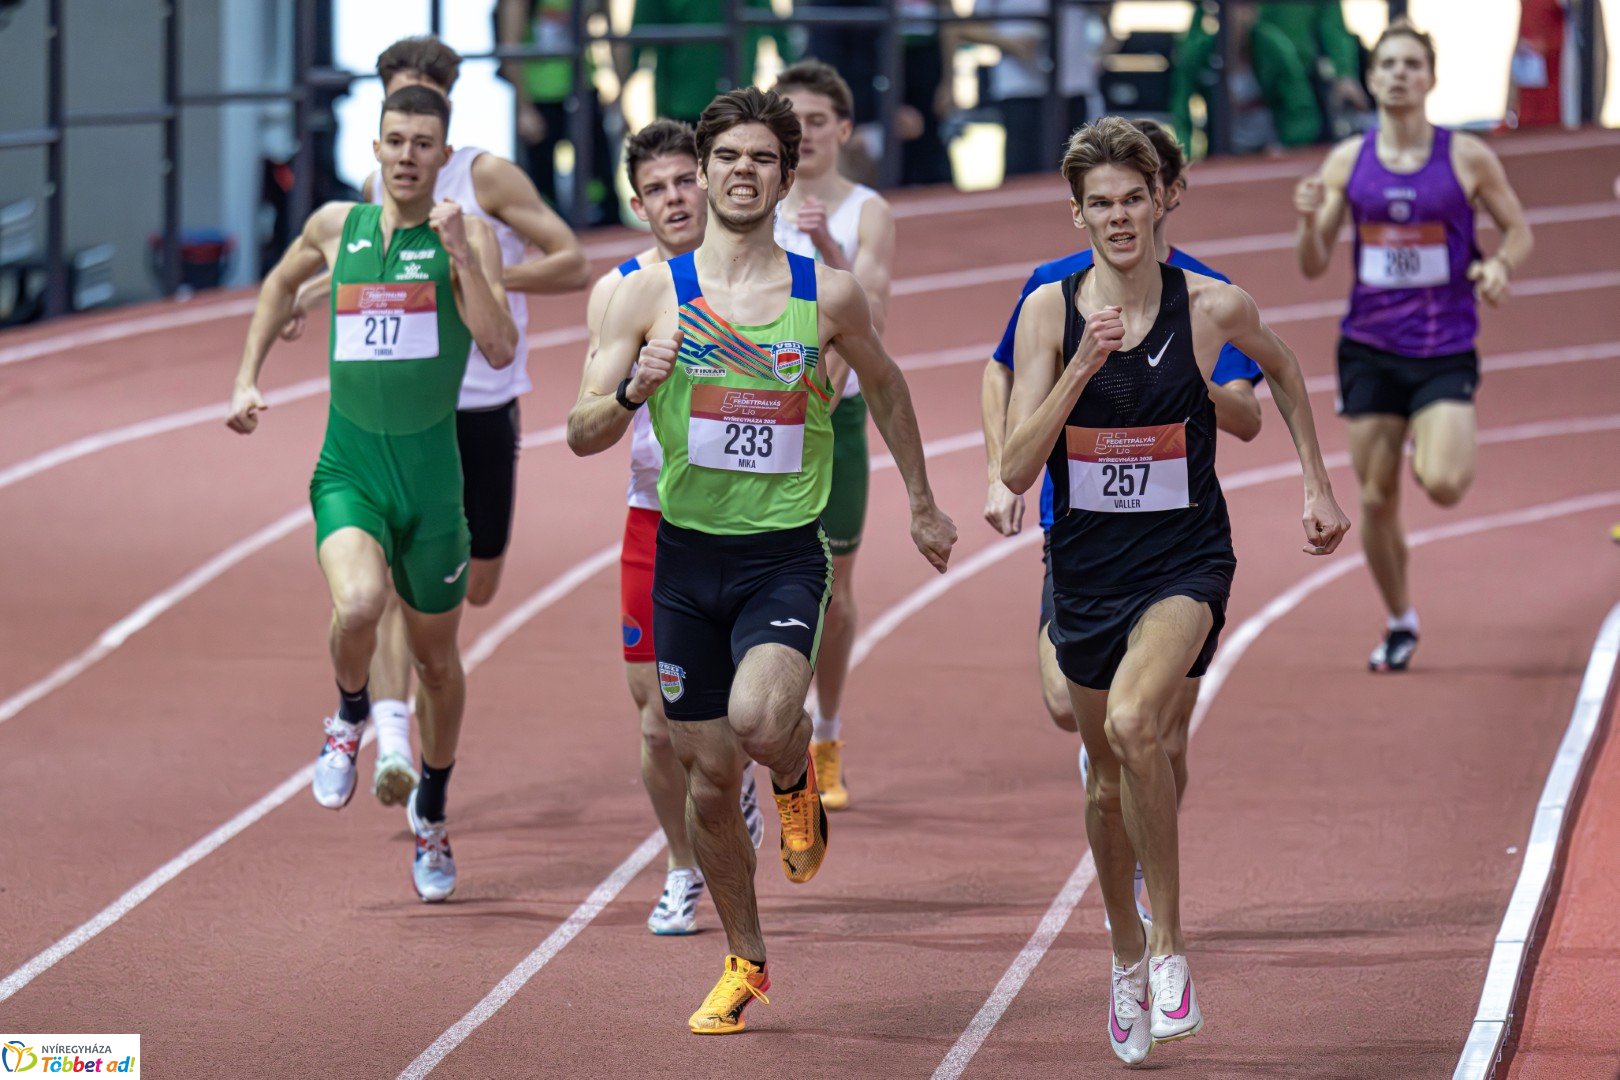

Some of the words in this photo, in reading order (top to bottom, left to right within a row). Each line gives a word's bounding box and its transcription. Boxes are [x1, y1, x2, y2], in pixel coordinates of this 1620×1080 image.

[365, 316, 401, 346] 217
[733, 398, 781, 407] FEDETTPÁLYÁS
[724, 423, 774, 457] 233
[1106, 436, 1156, 445] FEDETTPÁLYÁS
[738, 458, 756, 469] MIKA
[1102, 463, 1151, 497] 257
[1114, 499, 1141, 509] VALLER
